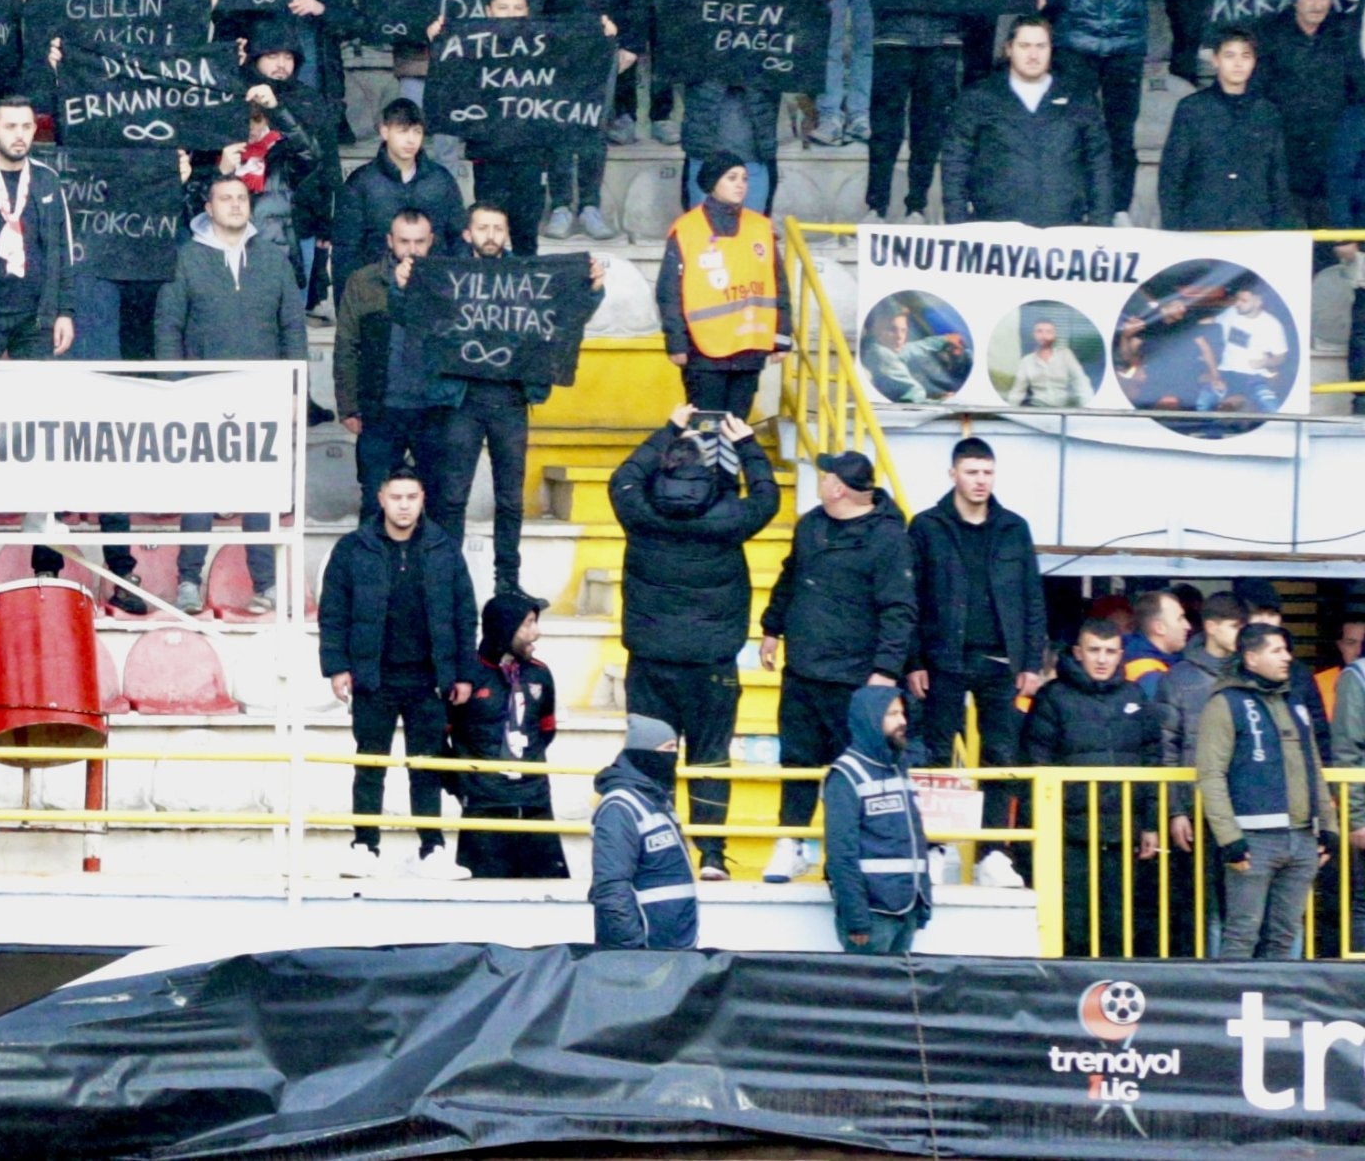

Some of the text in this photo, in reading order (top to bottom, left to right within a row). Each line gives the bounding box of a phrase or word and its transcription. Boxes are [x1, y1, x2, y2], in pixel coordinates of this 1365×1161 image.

[702, 0, 784, 25] EREN
[440, 31, 549, 62] ATLAS
[101, 54, 218, 87] DİLARA
[479, 66, 557, 90] KAAN
[496, 95, 603, 128] TOKCAN
[76, 212, 178, 239] TOKCAN
[870, 232, 1141, 284] UNUTMAYACAĞIZ
[449, 271, 553, 304] YILMAZ
[1049, 1045, 1180, 1079] trendyol
